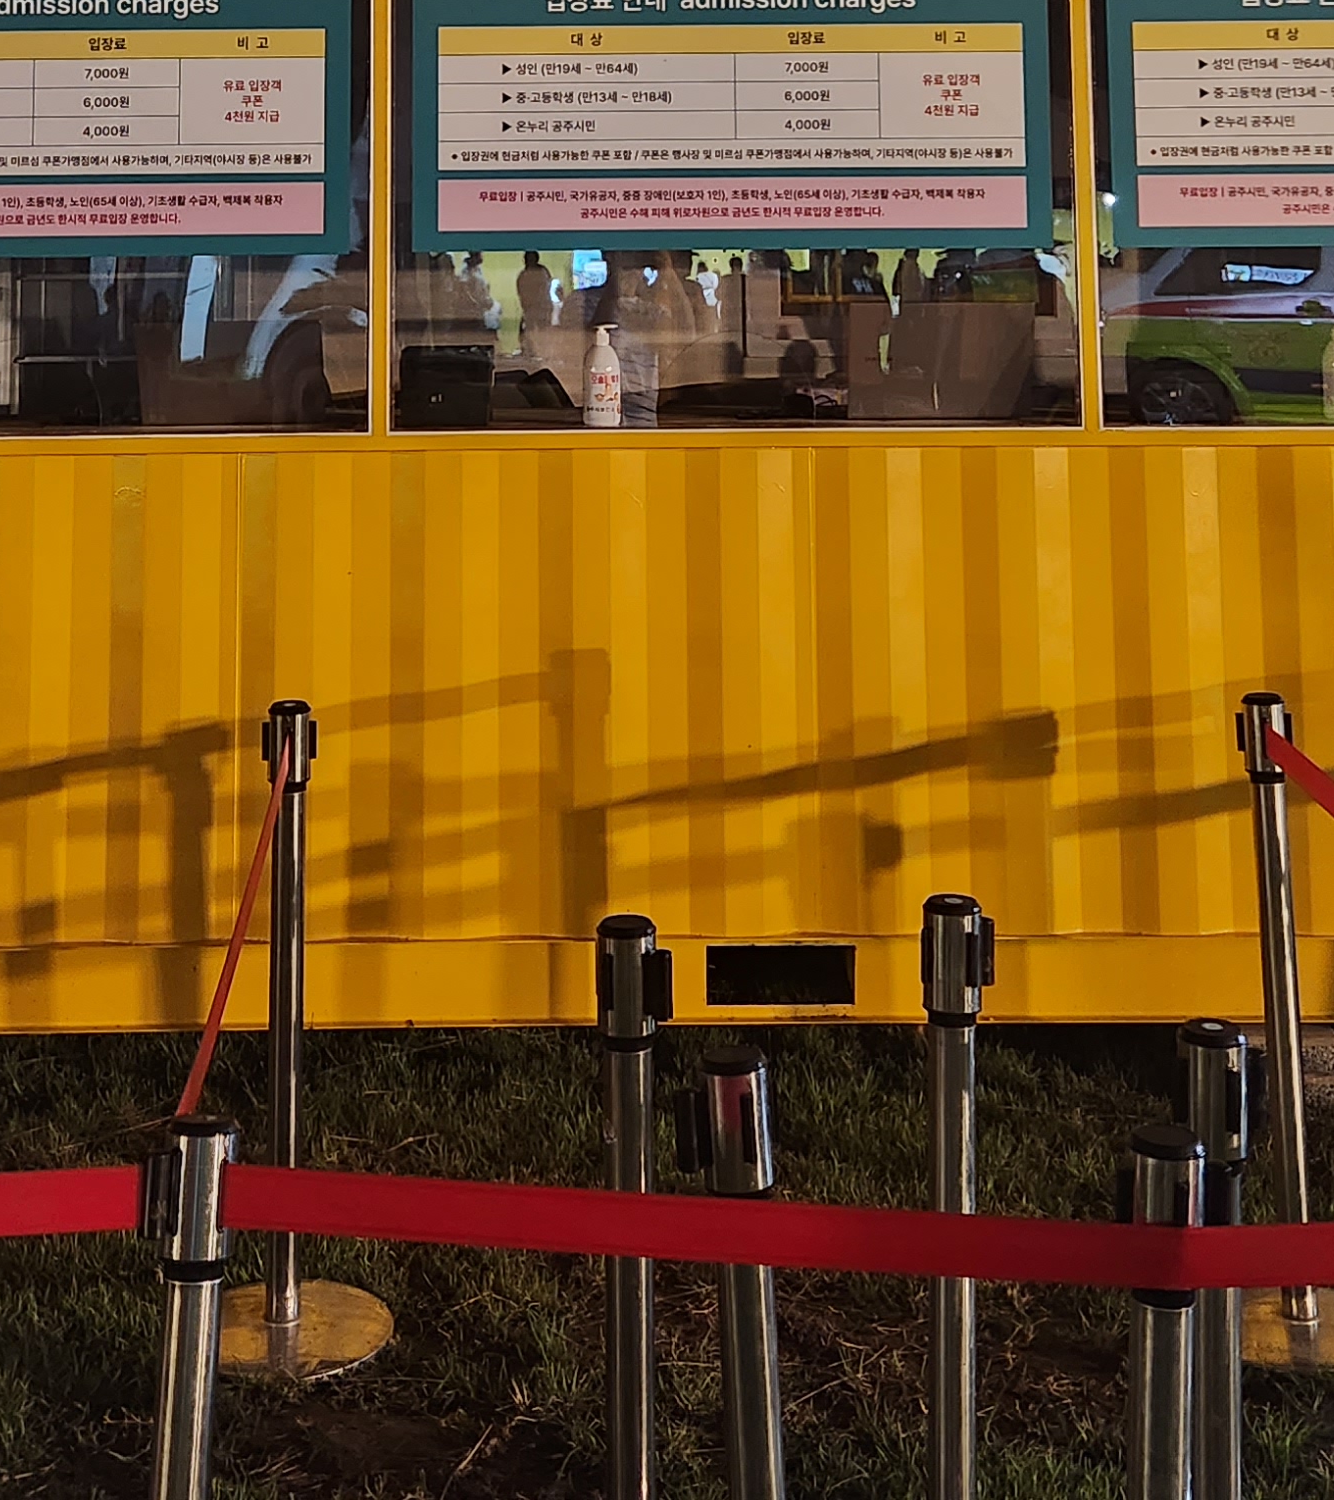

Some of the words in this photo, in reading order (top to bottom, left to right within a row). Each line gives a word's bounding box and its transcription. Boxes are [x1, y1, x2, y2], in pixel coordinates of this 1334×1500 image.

[87, 36, 127, 51] 입장료
[786, 30, 825, 45] 입장료
[515, 61, 538, 75] 성인
[540, 62, 581, 77] (만19세
[594, 61, 638, 76] 만64세)
[784, 60, 829, 75] 7,000원
[1211, 57, 1234, 70] 성인
[84, 66, 129, 82] 7,000원
[921, 73, 945, 86] 유료
[946, 73, 980, 86] 입장객
[222, 79, 245, 93] 유료
[247, 78, 281, 92] 입장객
[240, 94, 263, 108] 쿠폰
[783, 89, 830, 104] 6,000원
[939, 88, 962, 101] 쿠폰
[82, 95, 129, 110] 6,000원
[223, 109, 254, 123] 4천원
[257, 109, 280, 123] 지급
[923, 103, 954, 117] 4천원
[956, 103, 979, 117] 지급
[515, 119, 549, 133] 온누리
[551, 119, 595, 133] 공주시민
[783, 118, 831, 132] 4,000원
[1213, 115, 1248, 128] 온누리
[1250, 114, 1295, 128] 공주시민
[81, 123, 129, 139] 4,000원
